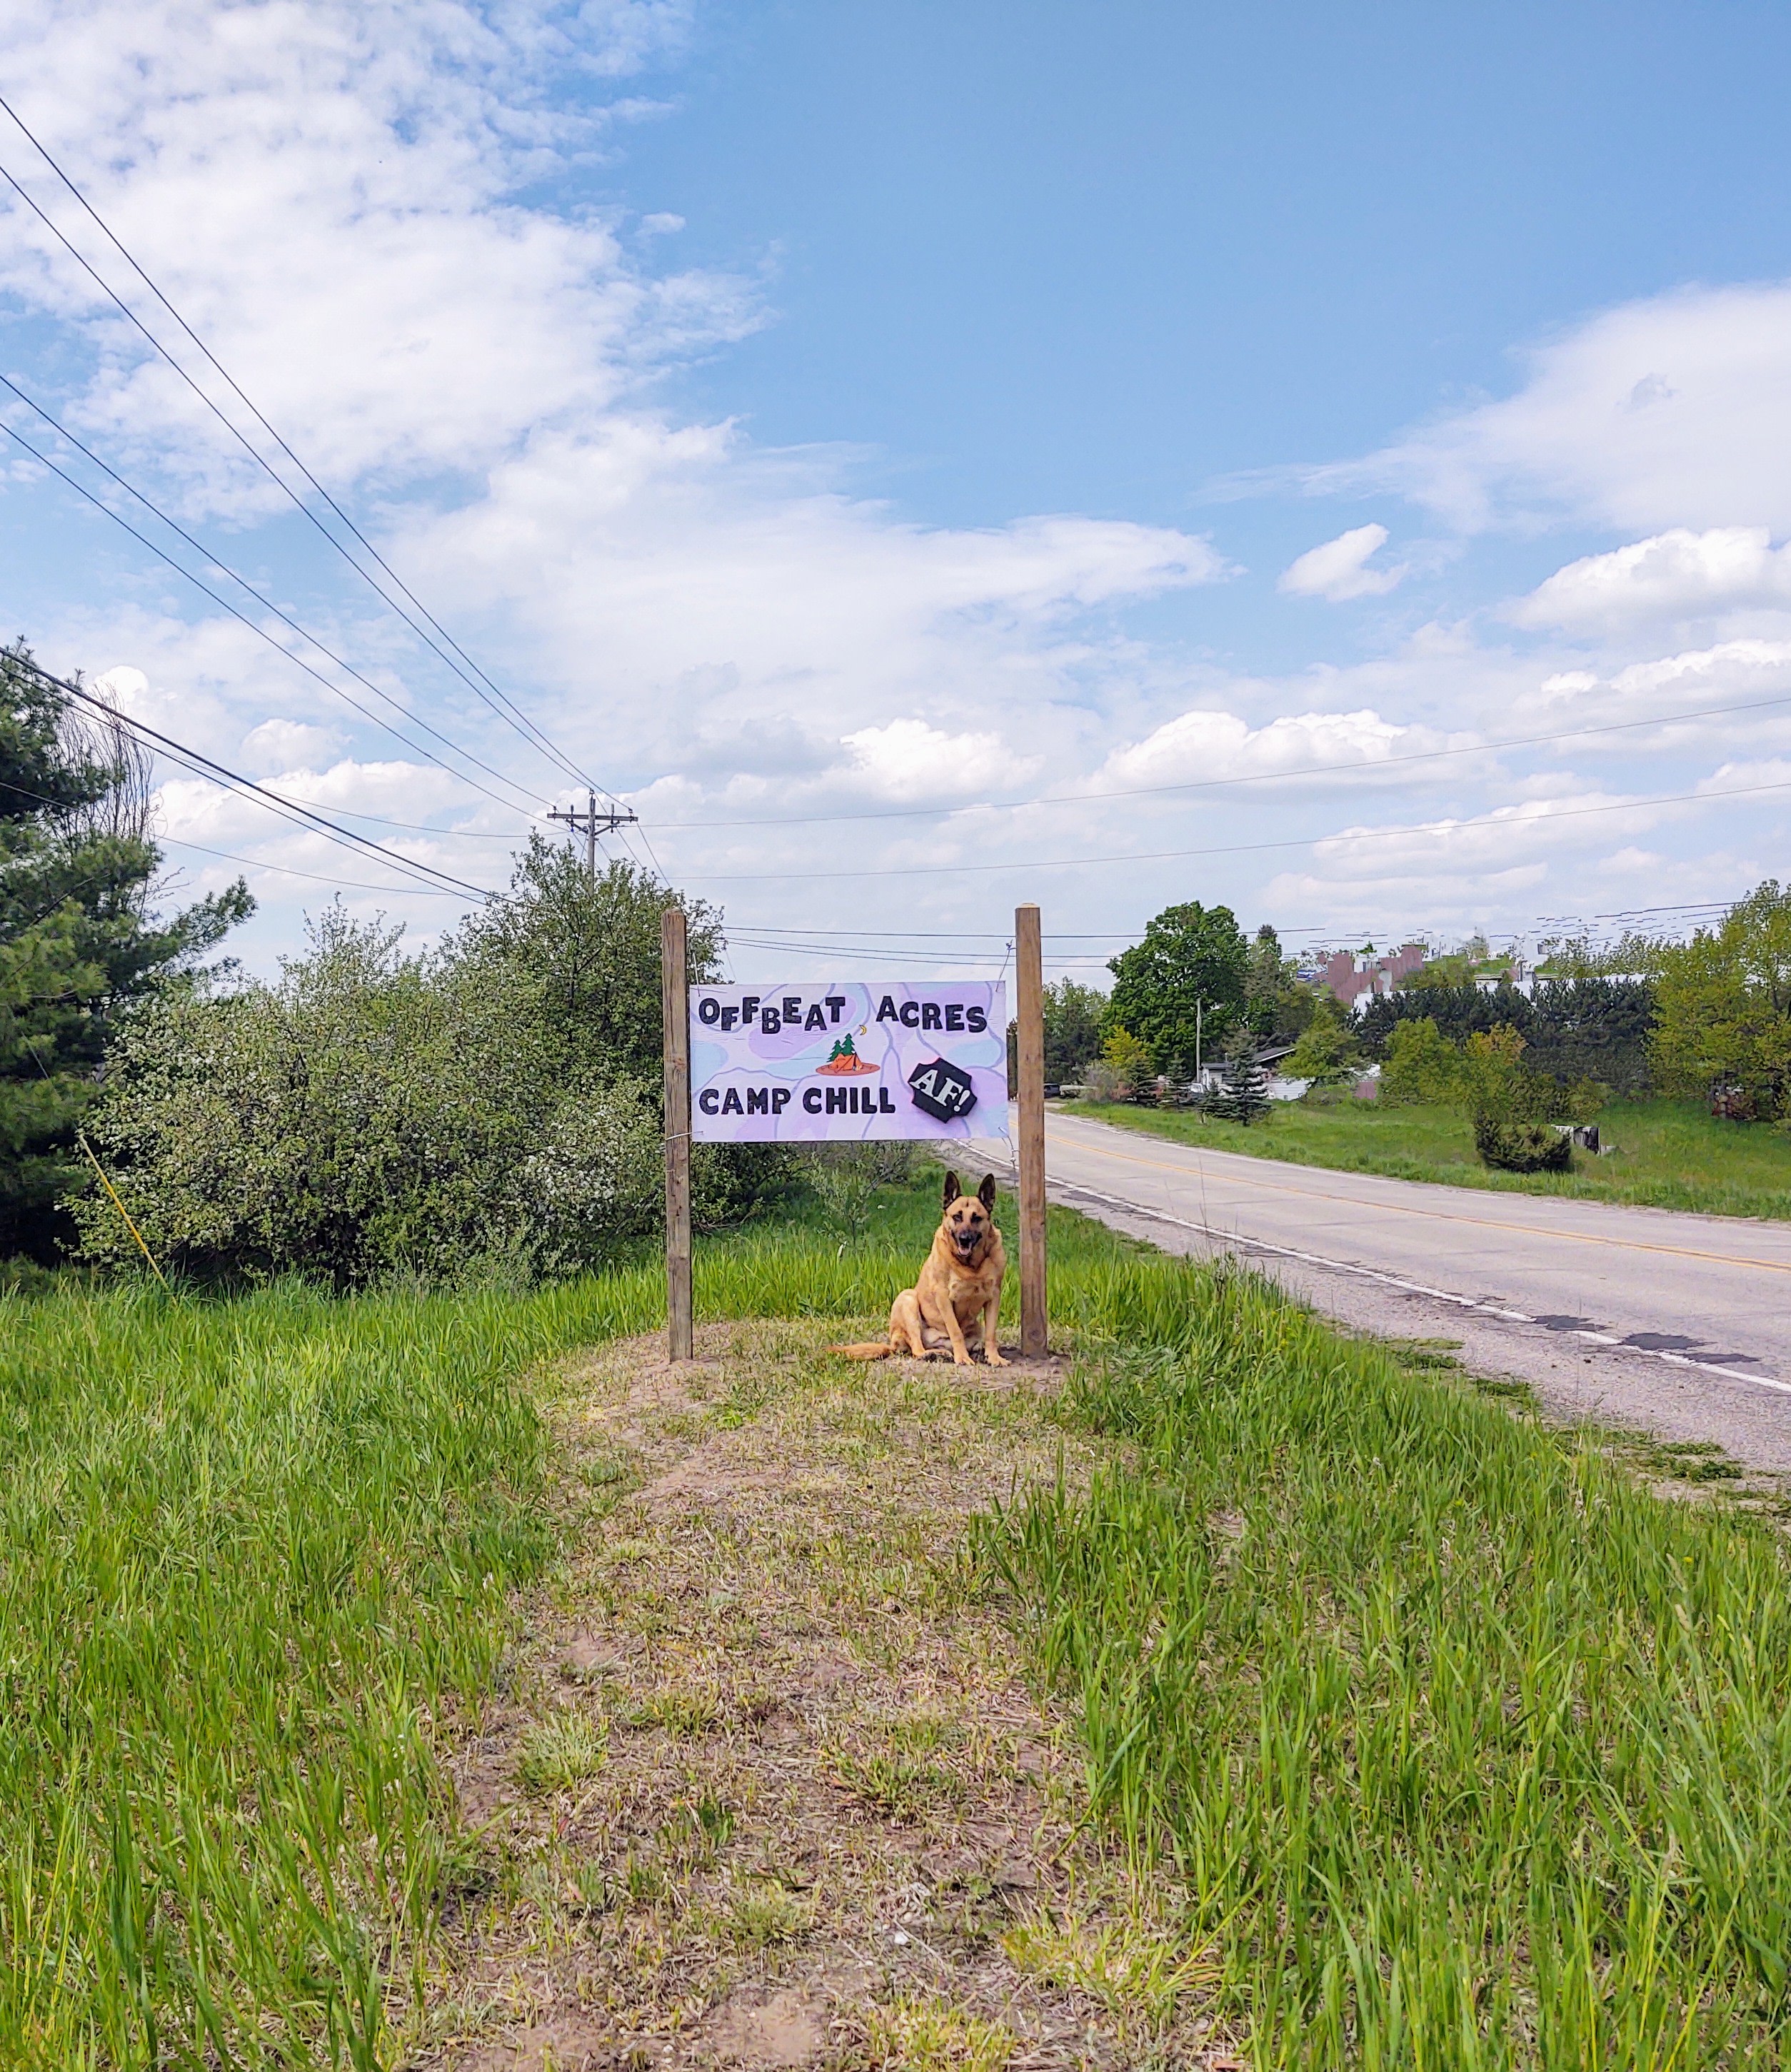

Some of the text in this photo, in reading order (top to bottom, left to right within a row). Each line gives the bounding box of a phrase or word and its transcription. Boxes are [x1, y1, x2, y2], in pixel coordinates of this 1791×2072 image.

[698, 995, 987, 1034] OFFBEAT ACRES
[698, 1069, 970, 1115] CAMP CHILL AF!
